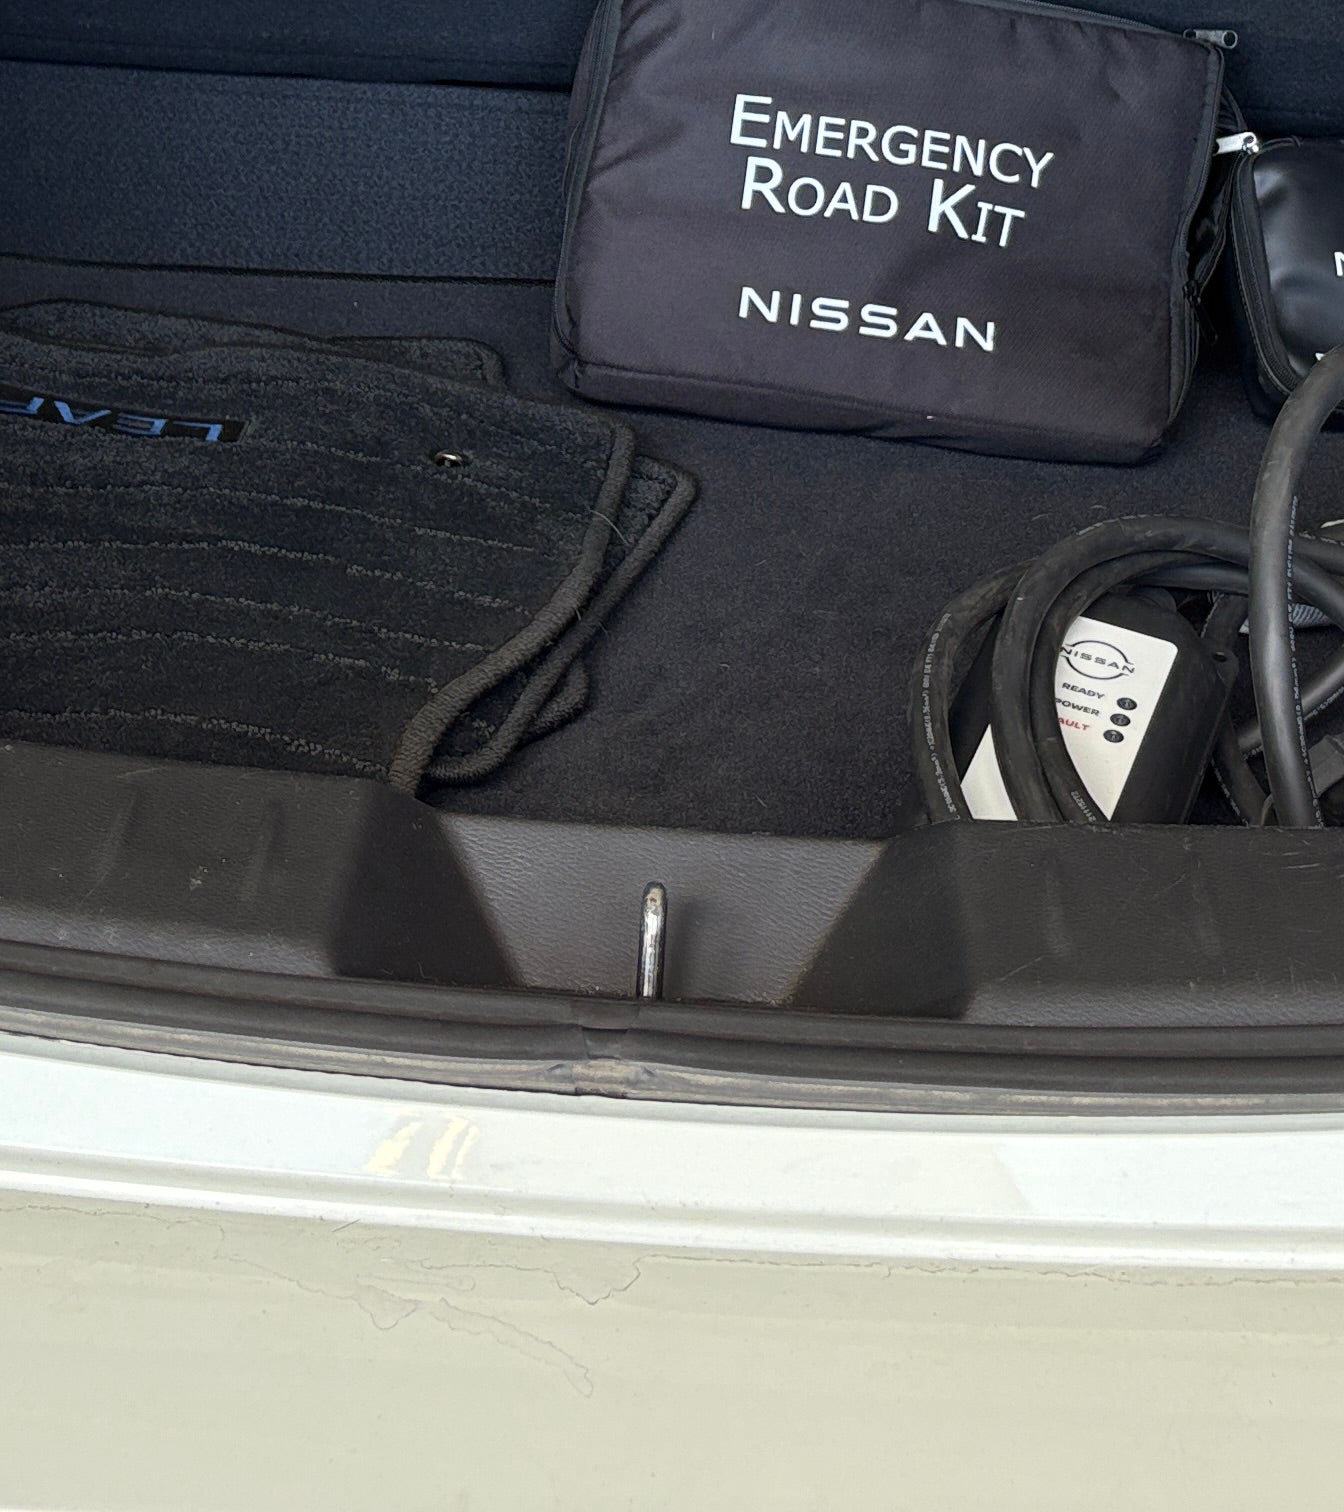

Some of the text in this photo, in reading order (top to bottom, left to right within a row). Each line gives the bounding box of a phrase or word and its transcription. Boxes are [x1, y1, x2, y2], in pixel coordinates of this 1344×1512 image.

[730, 93, 1054, 188] EMERGENCY
[741, 155, 1026, 247] ROAD KIT
[738, 286, 996, 352] NISSAN
[1059, 646, 1136, 673] NISSAN
[1062, 682, 1105, 699] READY
[1058, 717, 1090, 731] AULT
